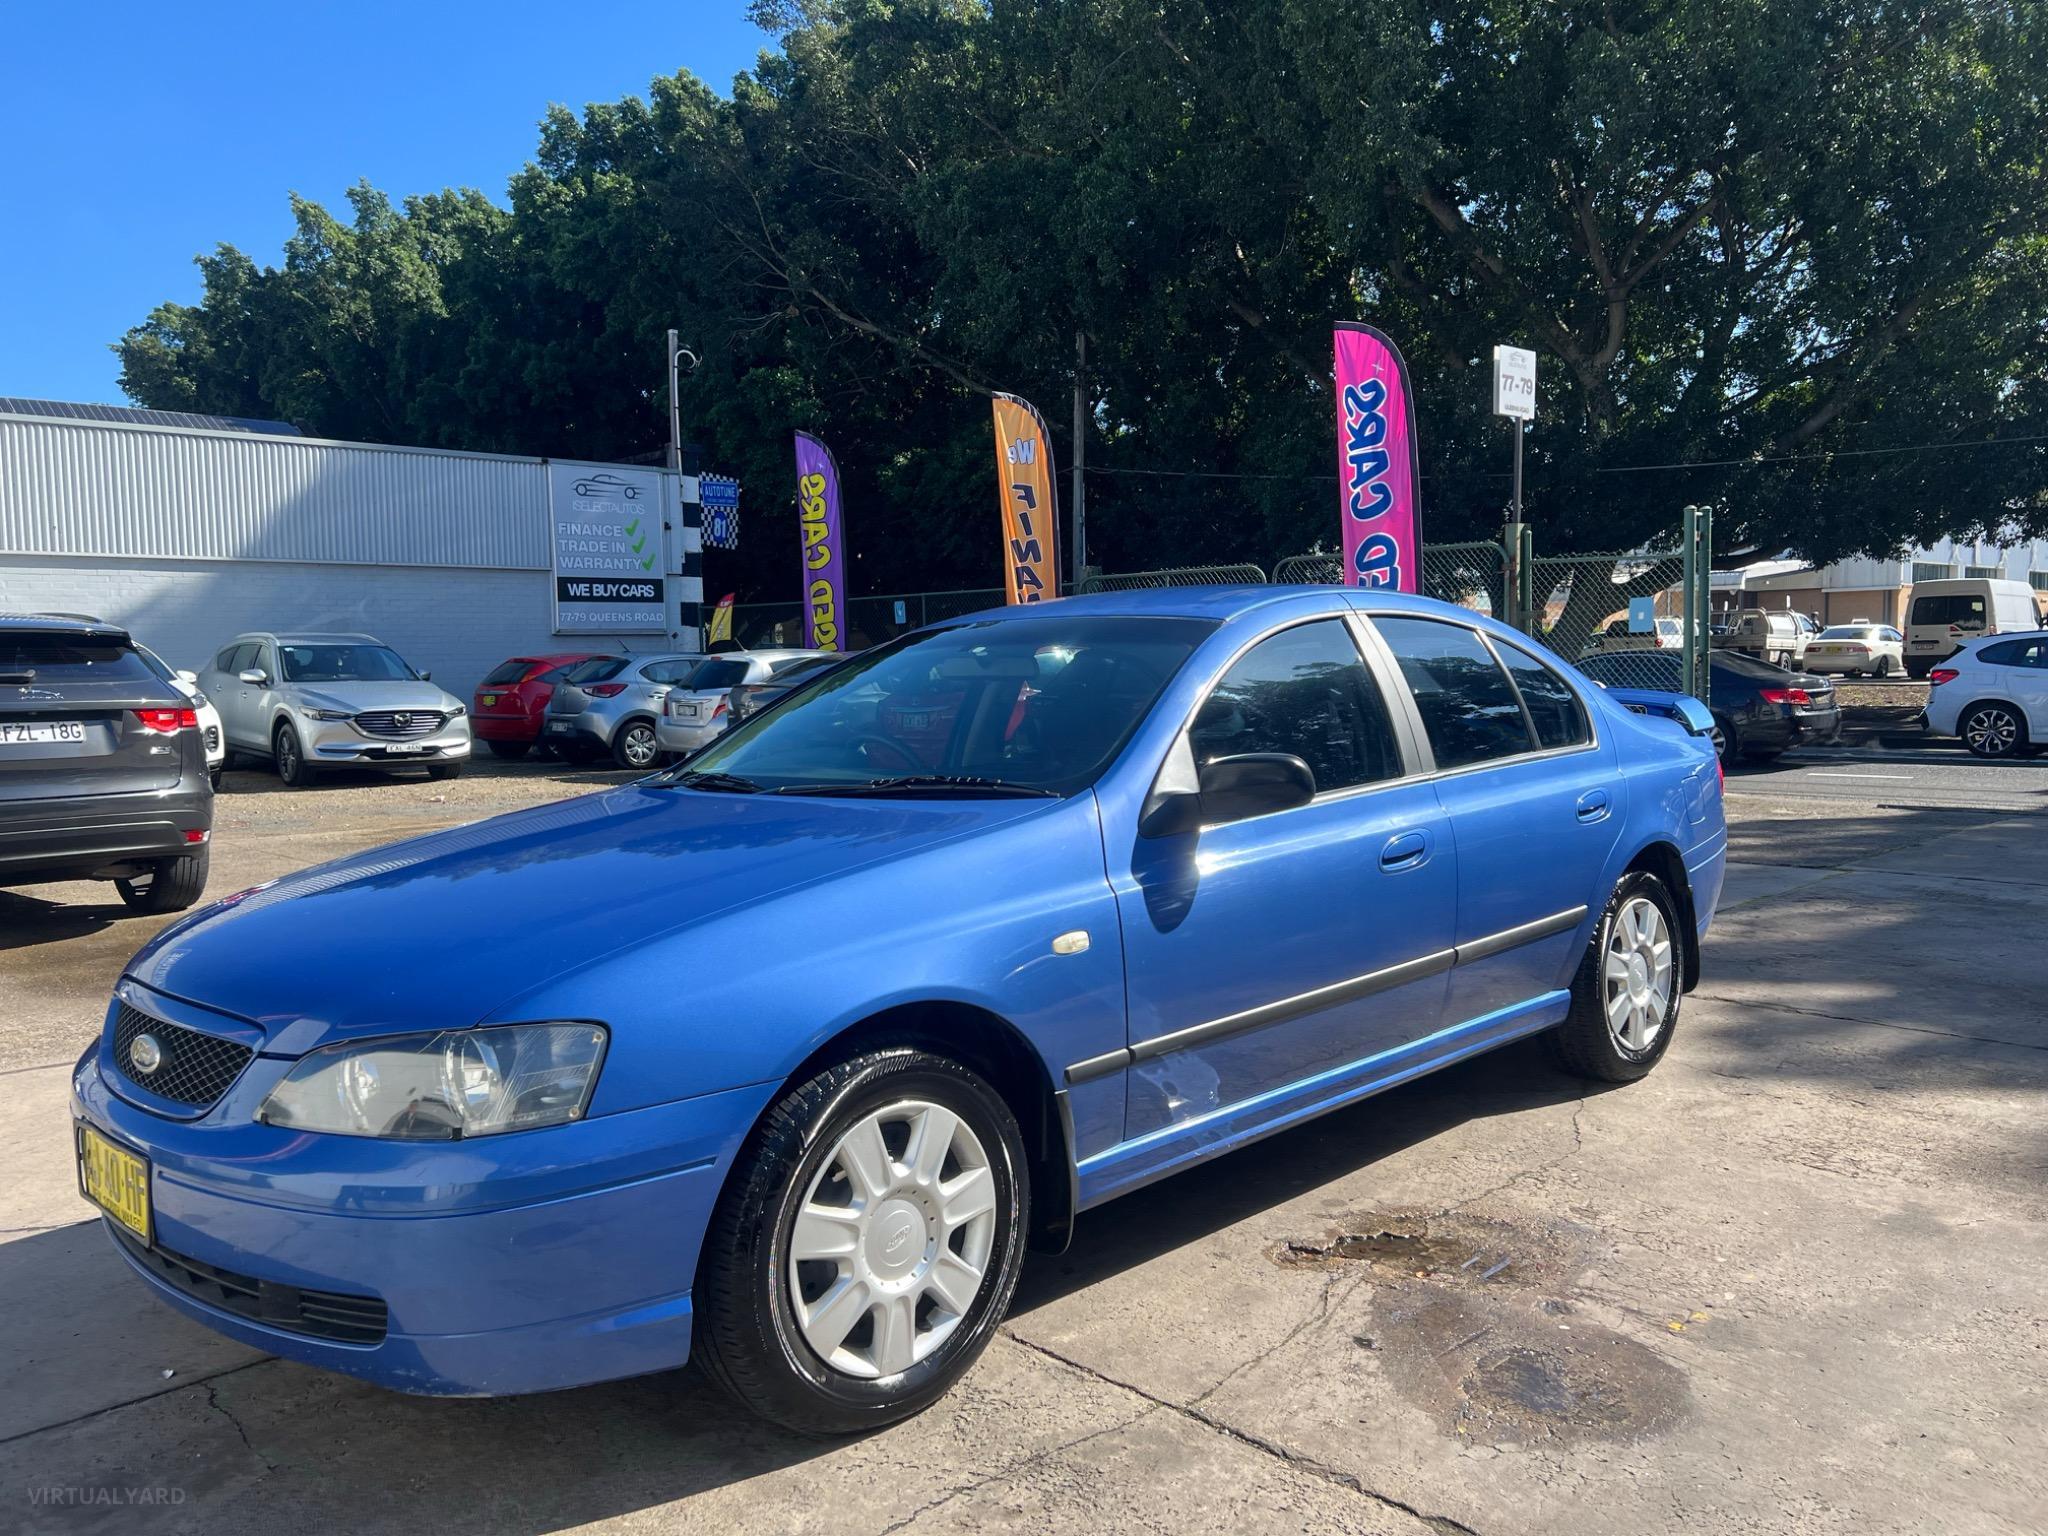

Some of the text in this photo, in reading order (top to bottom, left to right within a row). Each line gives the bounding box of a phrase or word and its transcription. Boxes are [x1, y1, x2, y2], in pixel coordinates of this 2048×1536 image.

[704, 485, 736, 498] AUTOTUNE
[558, 522, 623, 538] FINANCE
[713, 517, 727, 539] 81
[560, 539, 626, 554] TRADE IN
[560, 556, 642, 570] WARRANTY
[568, 583, 655, 598] WE BUY CARS
[589, 612, 633, 623] QUEENS
[634, 612, 665, 623] ROAD
